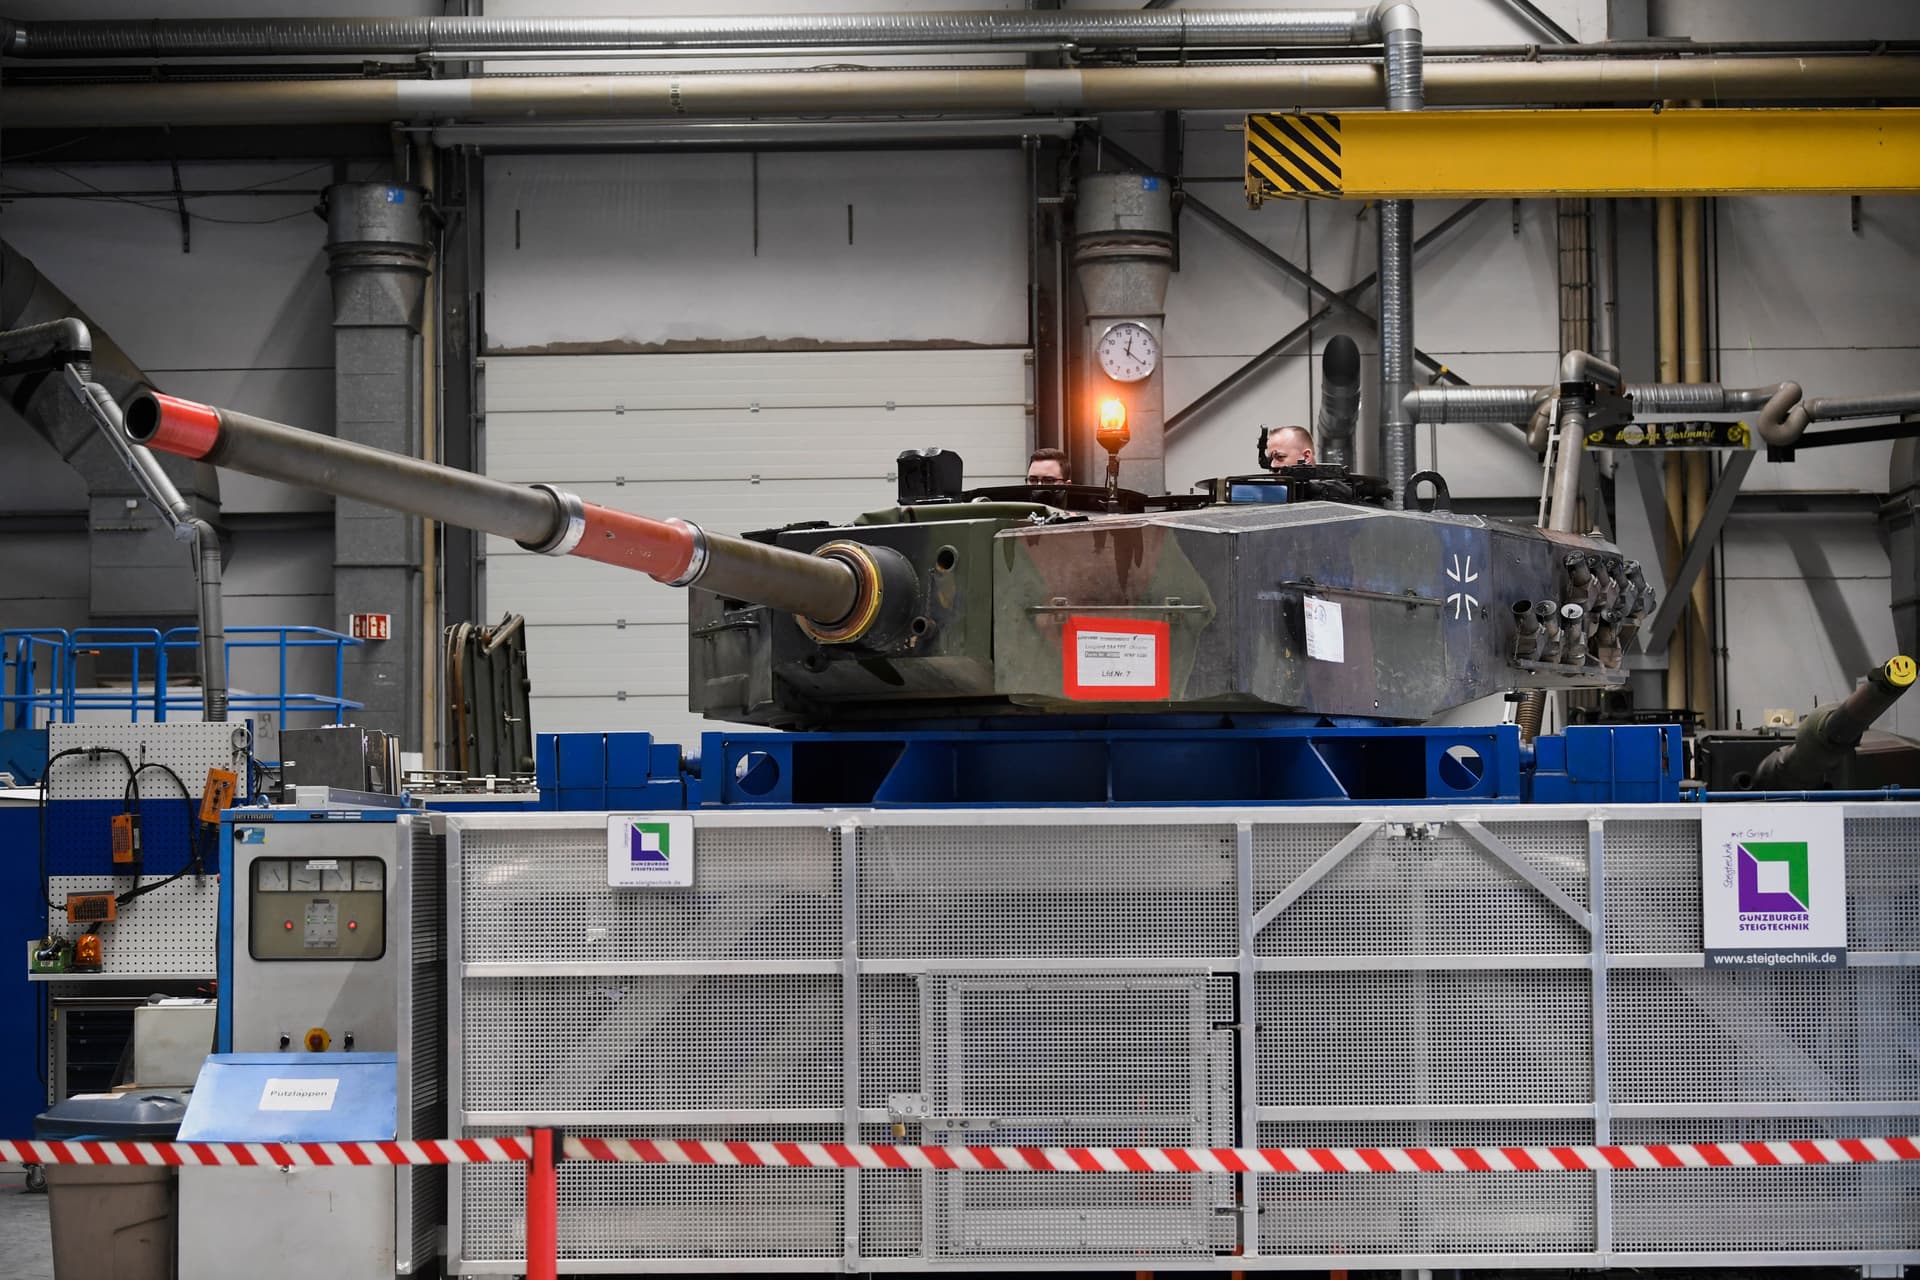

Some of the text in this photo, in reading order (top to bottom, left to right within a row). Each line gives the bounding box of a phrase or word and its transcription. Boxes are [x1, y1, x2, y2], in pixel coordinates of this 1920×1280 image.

[1739, 923, 1809, 931] STEIGTECHNIK
[1713, 952, 1837, 966] www.steigtechnik.de
[270, 1090, 328, 1098] Putzlappen
